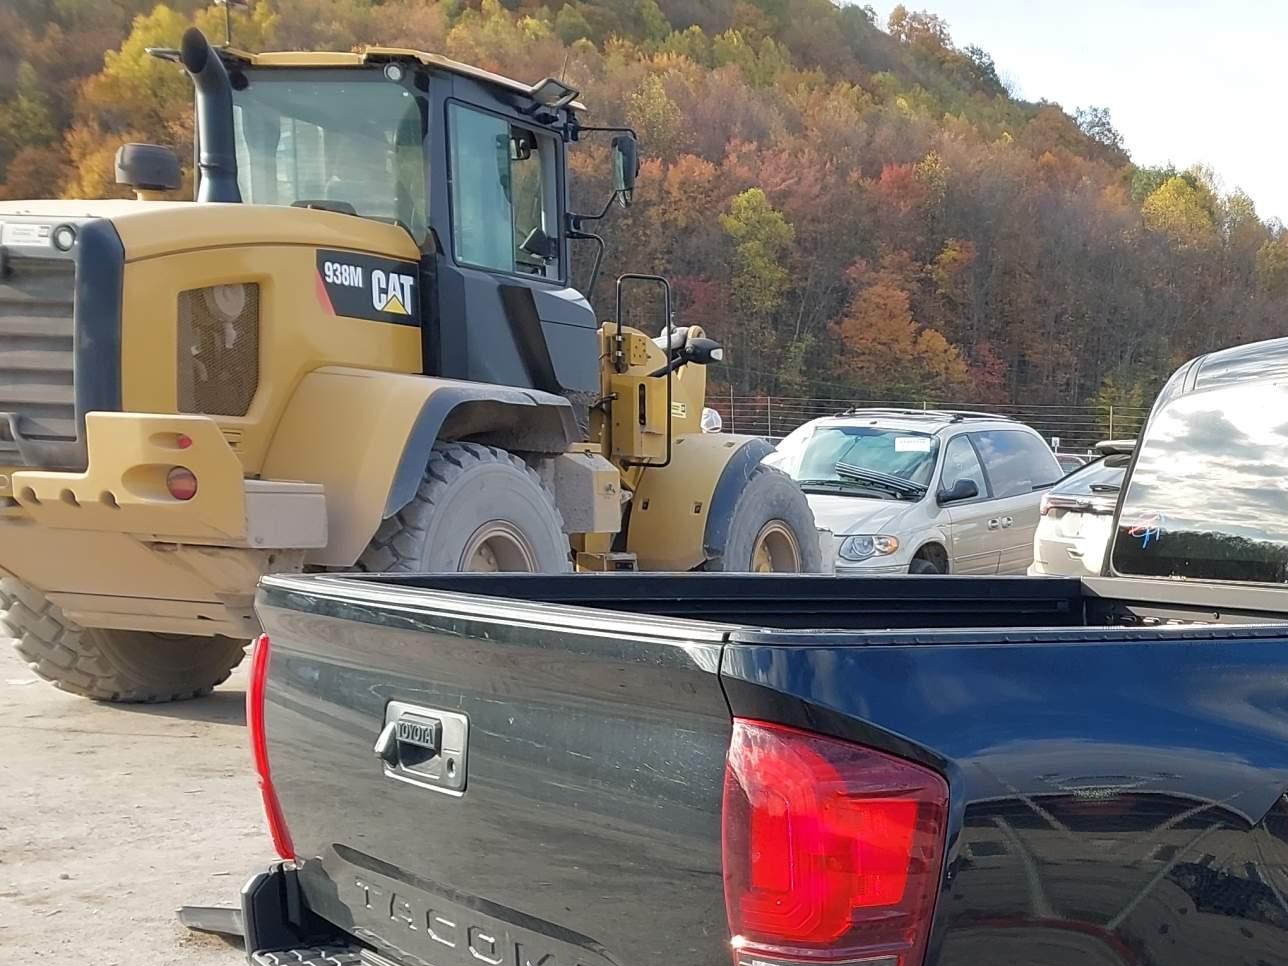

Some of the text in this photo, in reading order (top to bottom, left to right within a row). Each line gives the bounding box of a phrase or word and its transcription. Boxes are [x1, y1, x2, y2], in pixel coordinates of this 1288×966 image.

[324, 261, 414, 315] 938M CAT
[398, 721, 434, 745] TOYOTA
